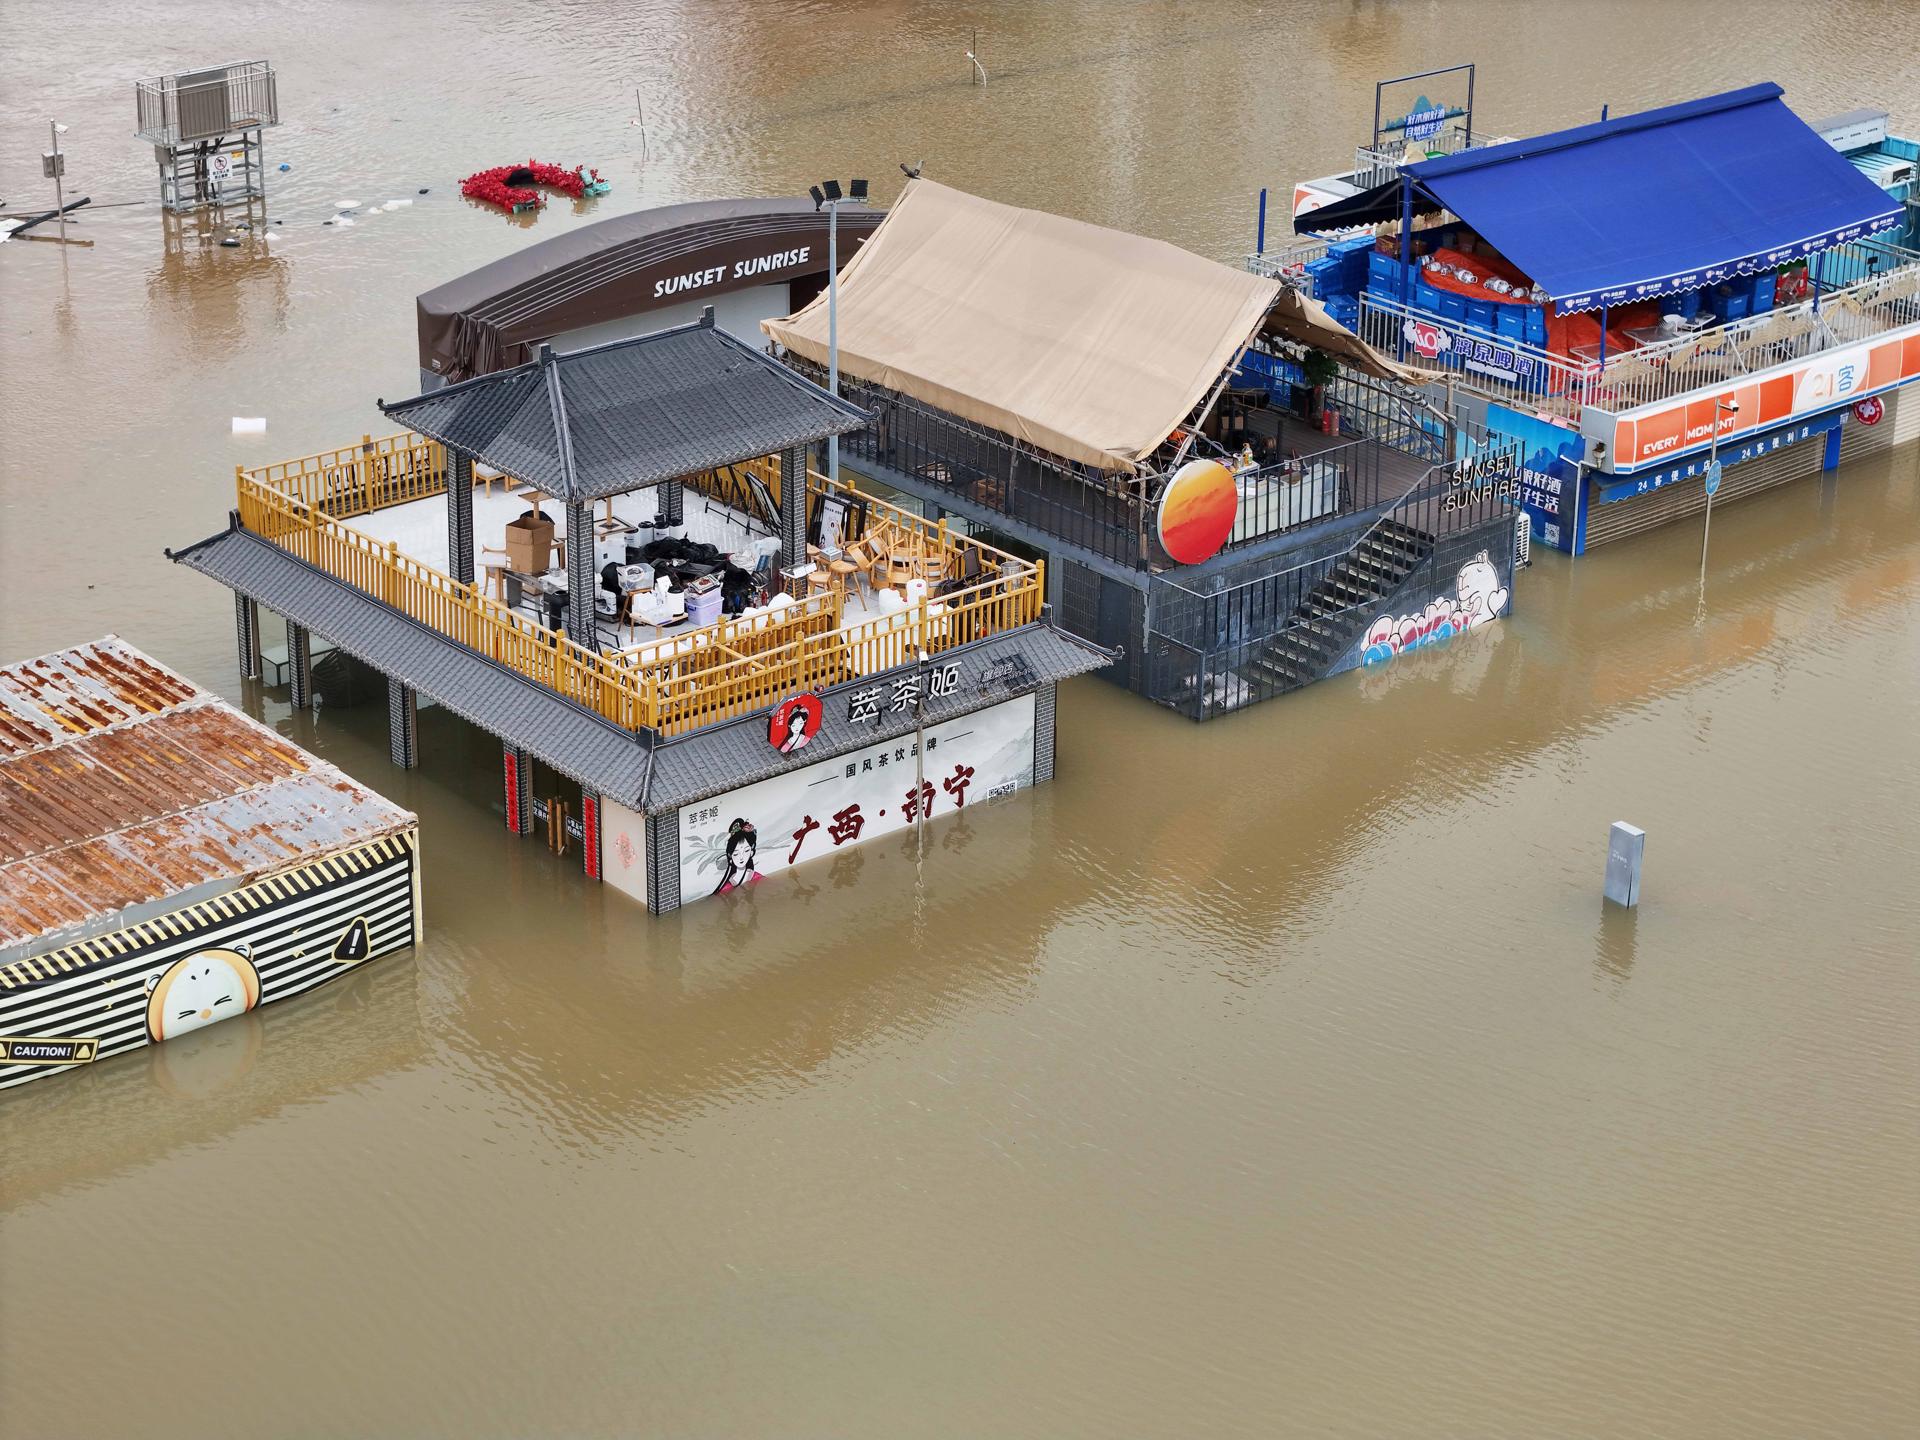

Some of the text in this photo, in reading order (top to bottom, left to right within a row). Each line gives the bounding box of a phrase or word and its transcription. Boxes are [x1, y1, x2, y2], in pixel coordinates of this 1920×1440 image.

[653, 246, 811, 298] SUNSET SUNRISE
[1454, 335, 1534, 377] 漓泉啤酒
[1643, 434, 1680, 455] EVERY
[1451, 452, 1515, 487] SUNSET
[1446, 477, 1521, 512] SUNRISE
[849, 661, 962, 723] 萃茶姬
[14, 1046, 72, 1056] CAUTION!
